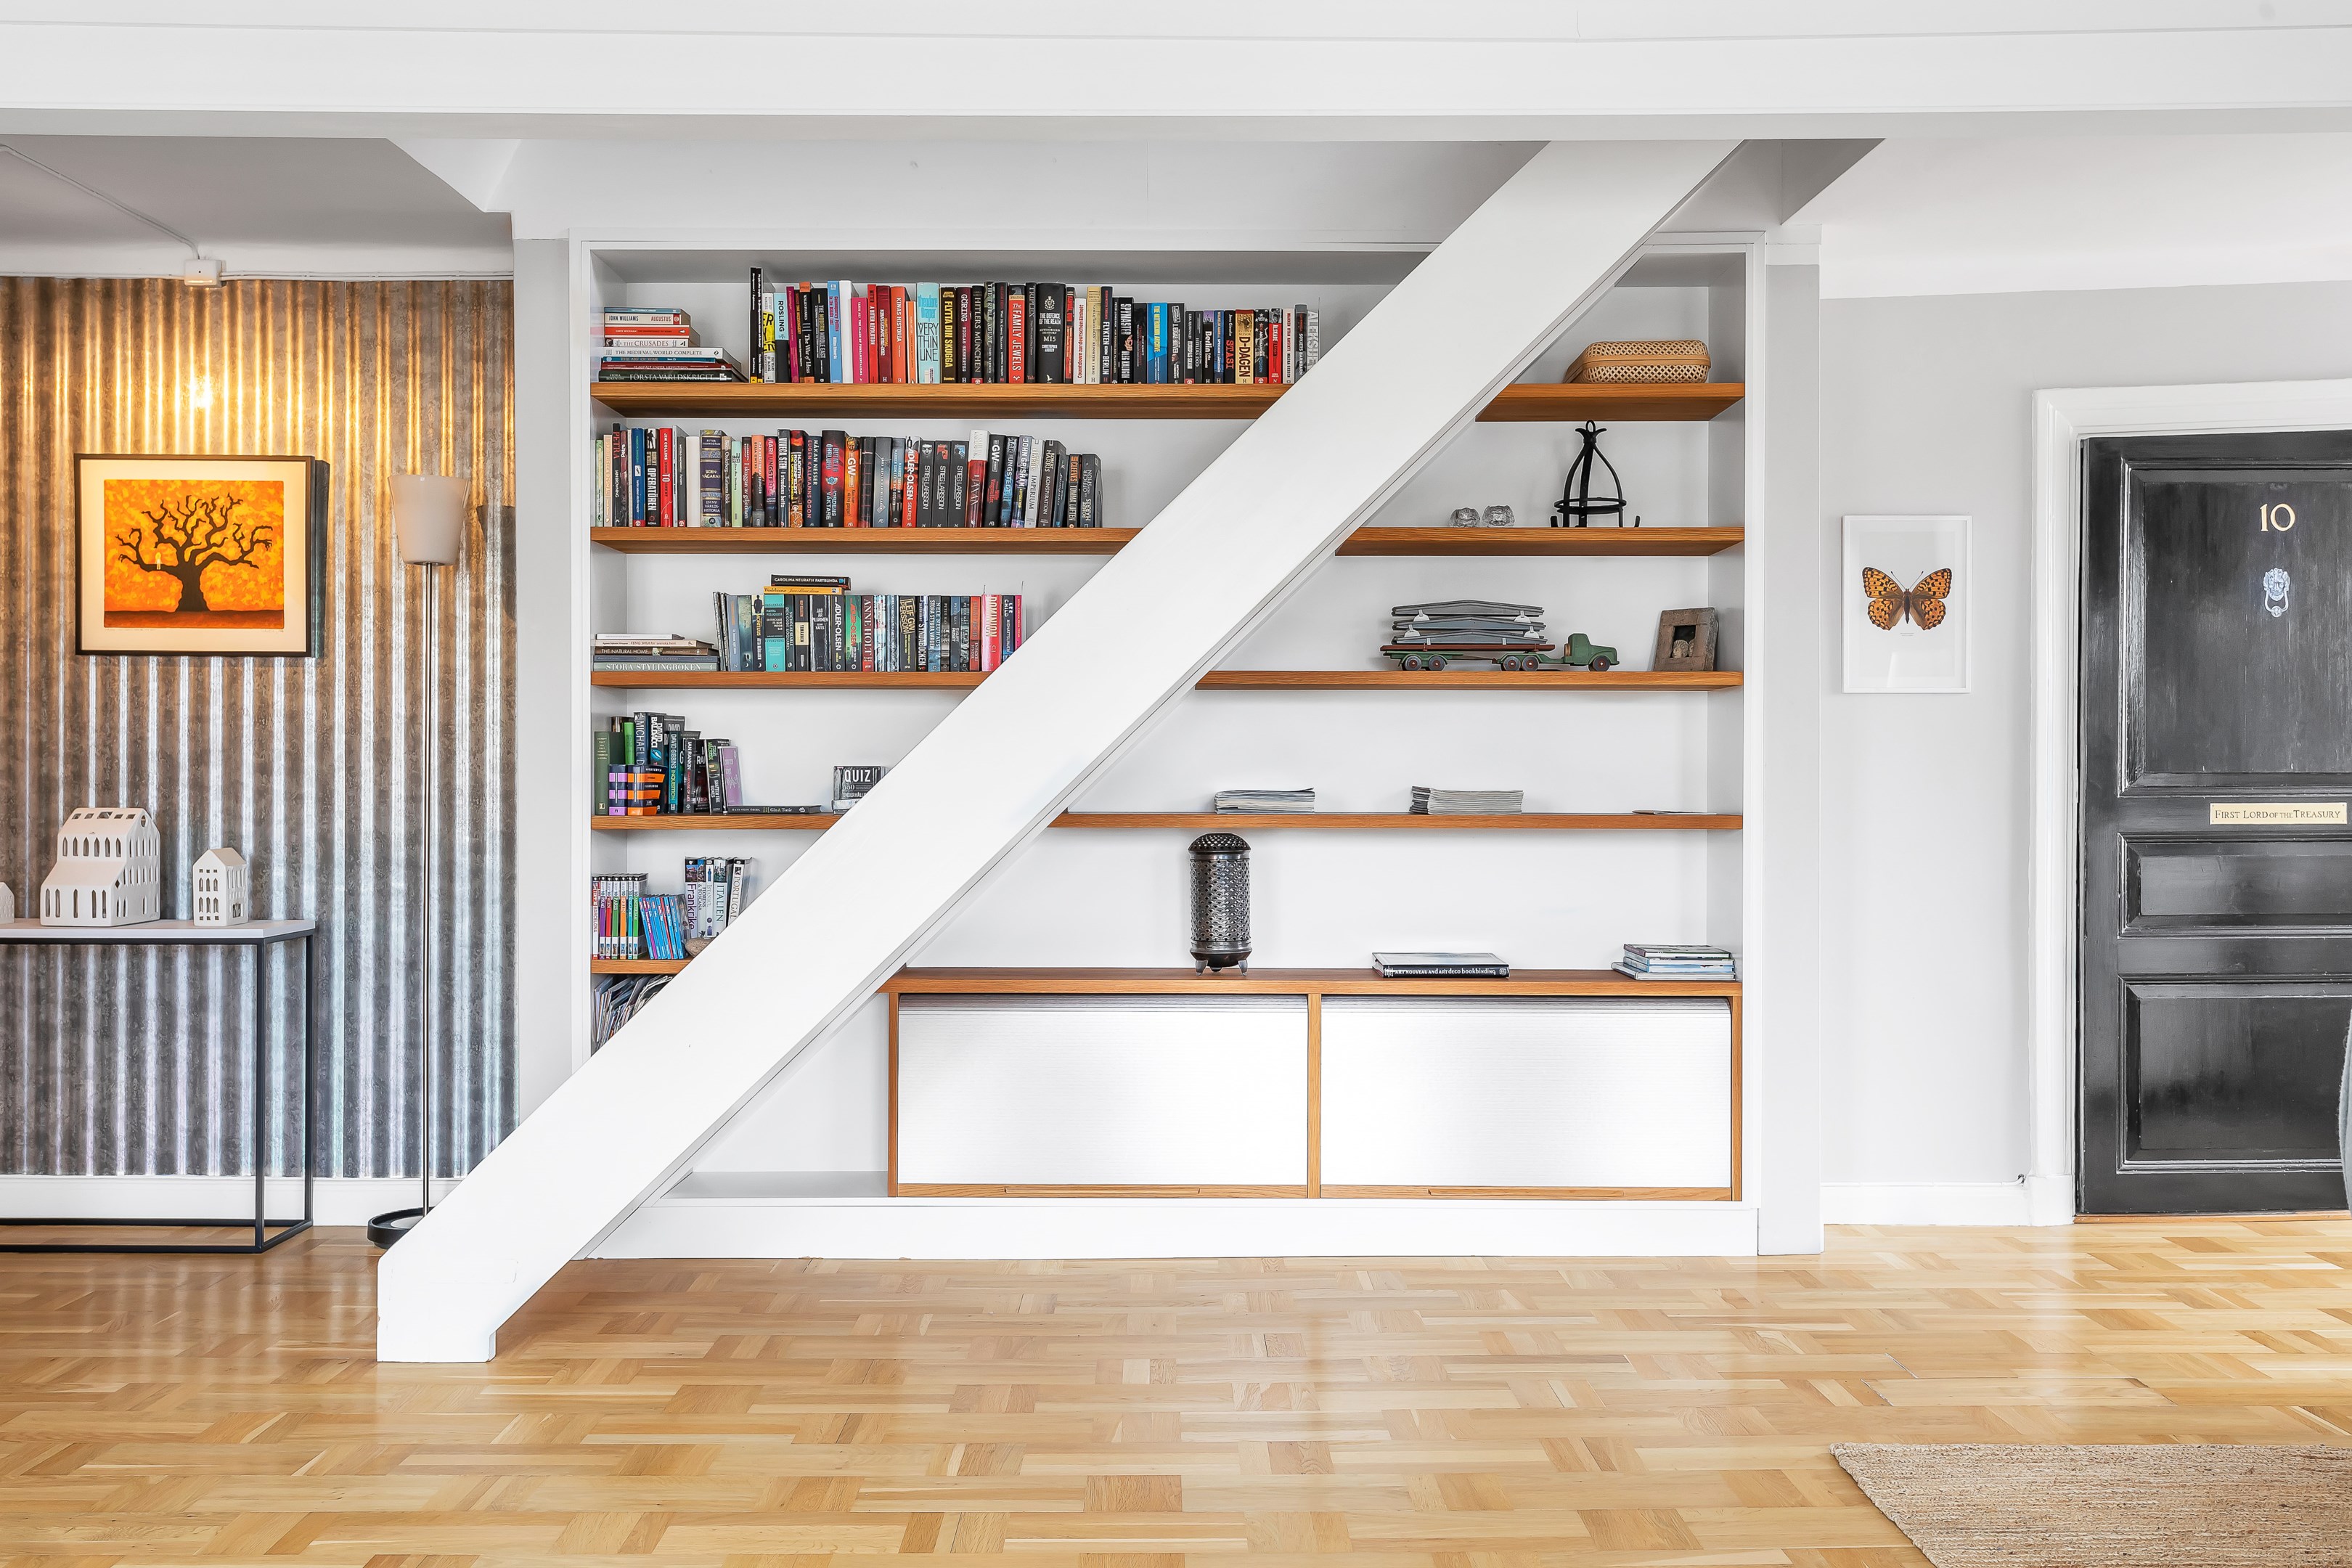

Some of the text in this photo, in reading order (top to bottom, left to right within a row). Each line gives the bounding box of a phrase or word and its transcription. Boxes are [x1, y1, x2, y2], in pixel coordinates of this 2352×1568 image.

[944, 301, 953, 368] FLYTTA DIN SKUGGA
[1120, 303, 1131, 335] SPYMASTER
[918, 335, 938, 348] THIN
[920, 348, 939, 362] LINE
[1012, 309, 1021, 370] FAMILY JEWELS
[1239, 336, 1251, 377] D-DAGEN
[778, 438, 788, 456] VIVECA
[992, 445, 1000, 462] GW
[778, 457, 788, 469] STEN
[848, 457, 857, 475] GW
[1018, 458, 1027, 487] GRISHAM
[648, 467, 658, 511] OPERATÖREN
[1069, 504, 1077, 521] LUFTEN
[2259, 503, 2295, 531] 10
[900, 601, 909, 632] PERSSON
[905, 600, 915, 631] LEIF GW
[986, 597, 997, 637] DOMINION
[918, 624, 926, 666] SYNDABOCKEN
[636, 721, 645, 756] MICHAEL
[844, 769, 871, 783] QUIZ
[2215, 810, 2239, 819] FIRST
[2243, 810, 2269, 819] LORD
[2292, 809, 2341, 818] TREASURY
[687, 883, 697, 930] Frankrike
[716, 885, 724, 922] ITALIEN
[730, 876, 740, 919] PORTUGAL
